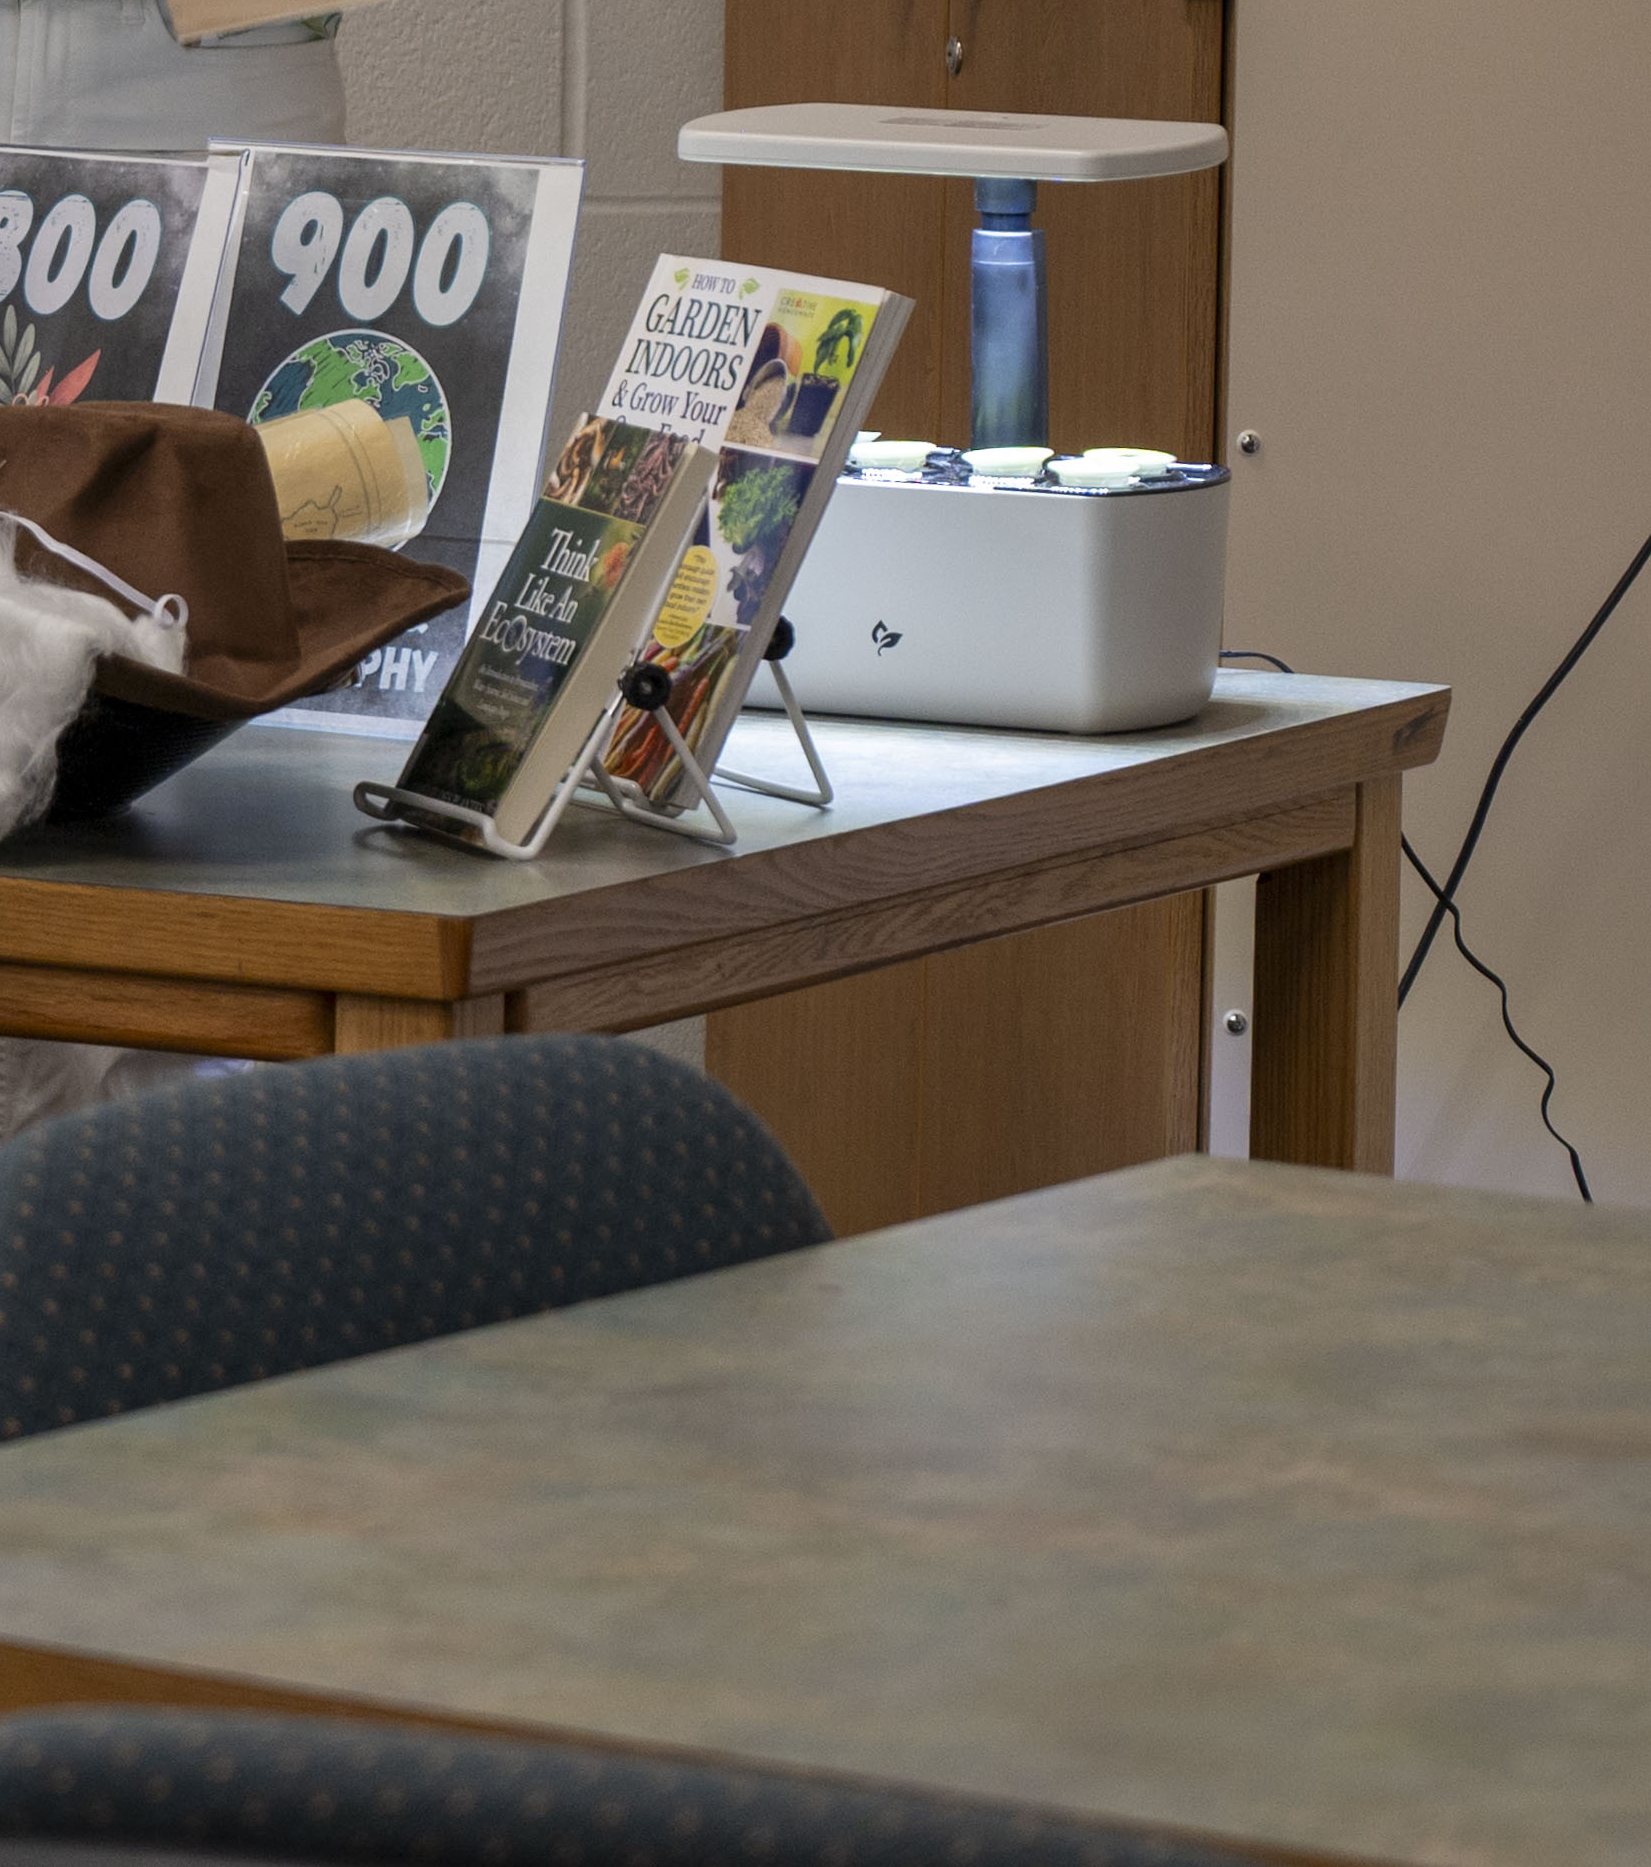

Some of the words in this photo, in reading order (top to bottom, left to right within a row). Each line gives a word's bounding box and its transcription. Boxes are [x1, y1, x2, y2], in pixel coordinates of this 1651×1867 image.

[271, 190, 491, 326] 900
[691, 273, 719, 292] HOW
[720, 277, 737, 294] TO
[646, 293, 762, 348] GARDEN
[625, 338, 744, 391] INDOORS
[612, 379, 628, 407] &
[630, 382, 679, 417] Grow
[680, 391, 728, 426] Your
[541, 527, 601, 582] Think
[514, 573, 555, 617] Like
[549, 586, 578, 624] An
